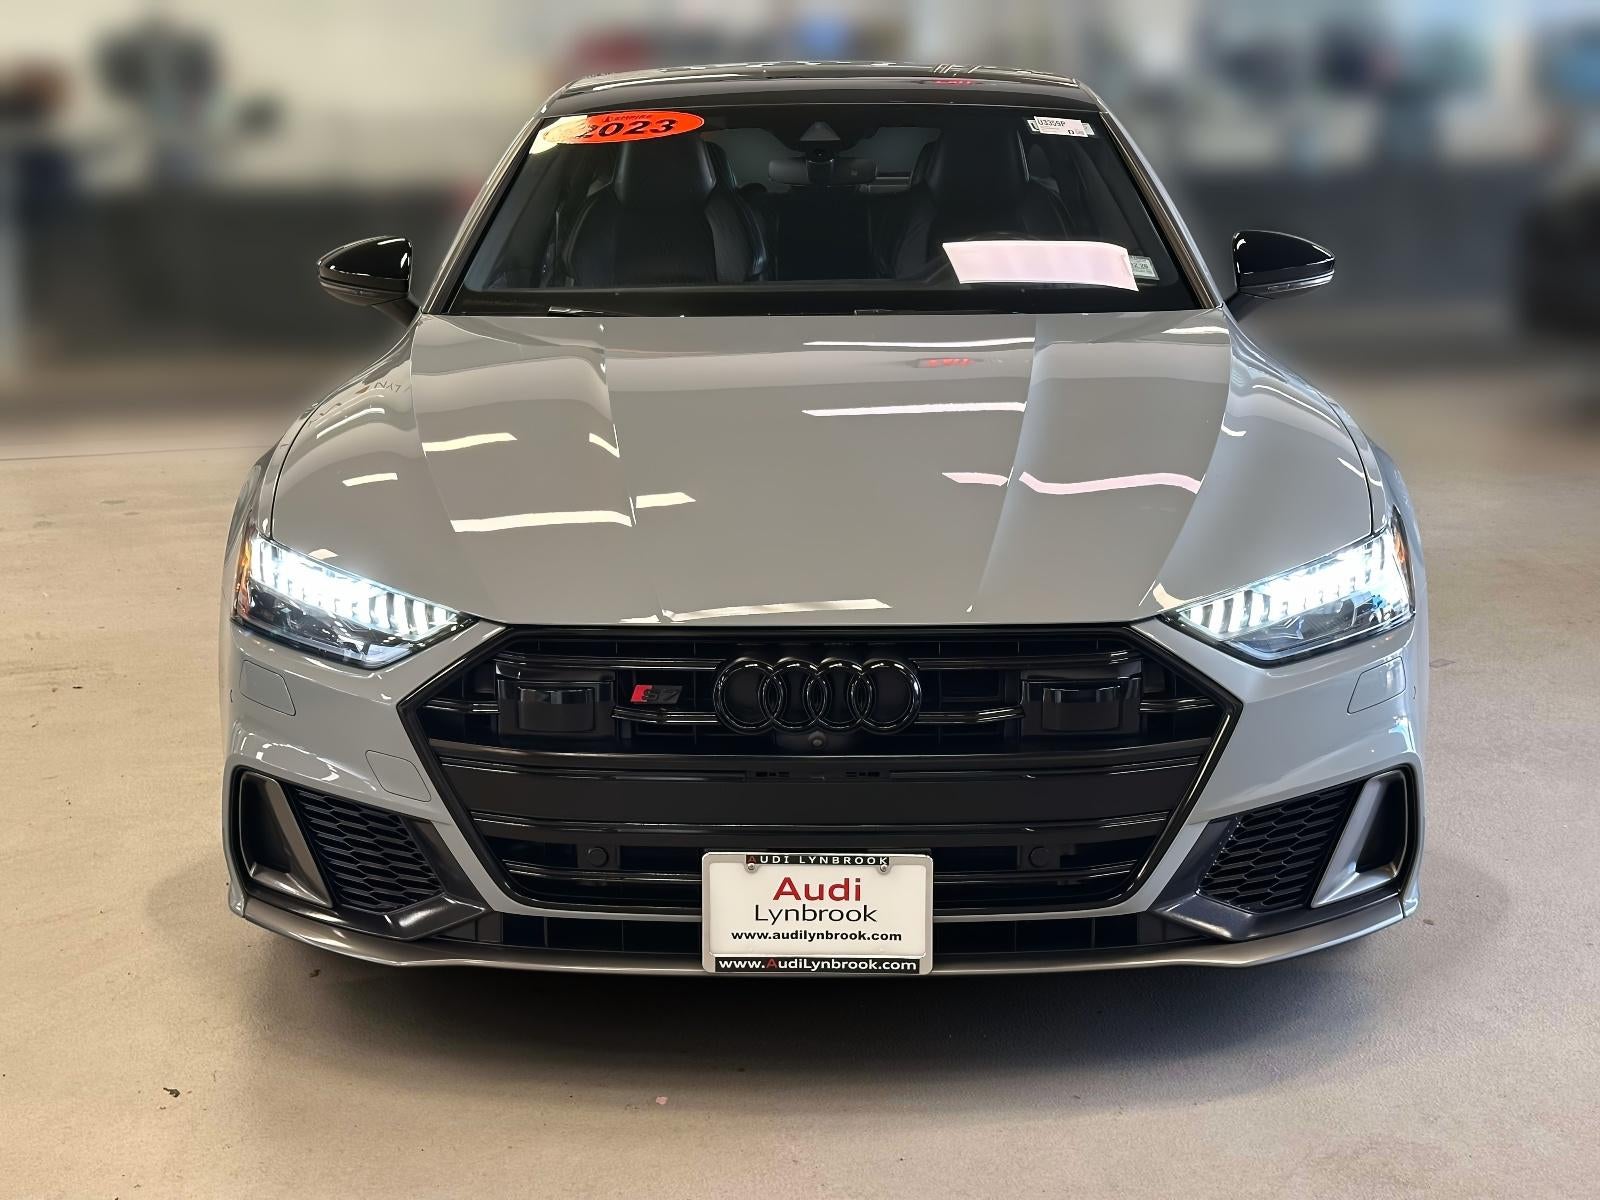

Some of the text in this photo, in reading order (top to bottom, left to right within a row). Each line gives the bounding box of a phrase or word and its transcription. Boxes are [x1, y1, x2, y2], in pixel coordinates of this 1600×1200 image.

[575, 119, 677, 139] 2023
[638, 686, 680, 702] S7
[748, 854, 888, 865] AUDI LYNBROOK
[772, 876, 862, 901] Audi
[755, 903, 878, 926] Lynbrook
[731, 930, 902, 943] www.audilynbrook.com
[718, 957, 918, 972] www.AudiLynbrook.com
